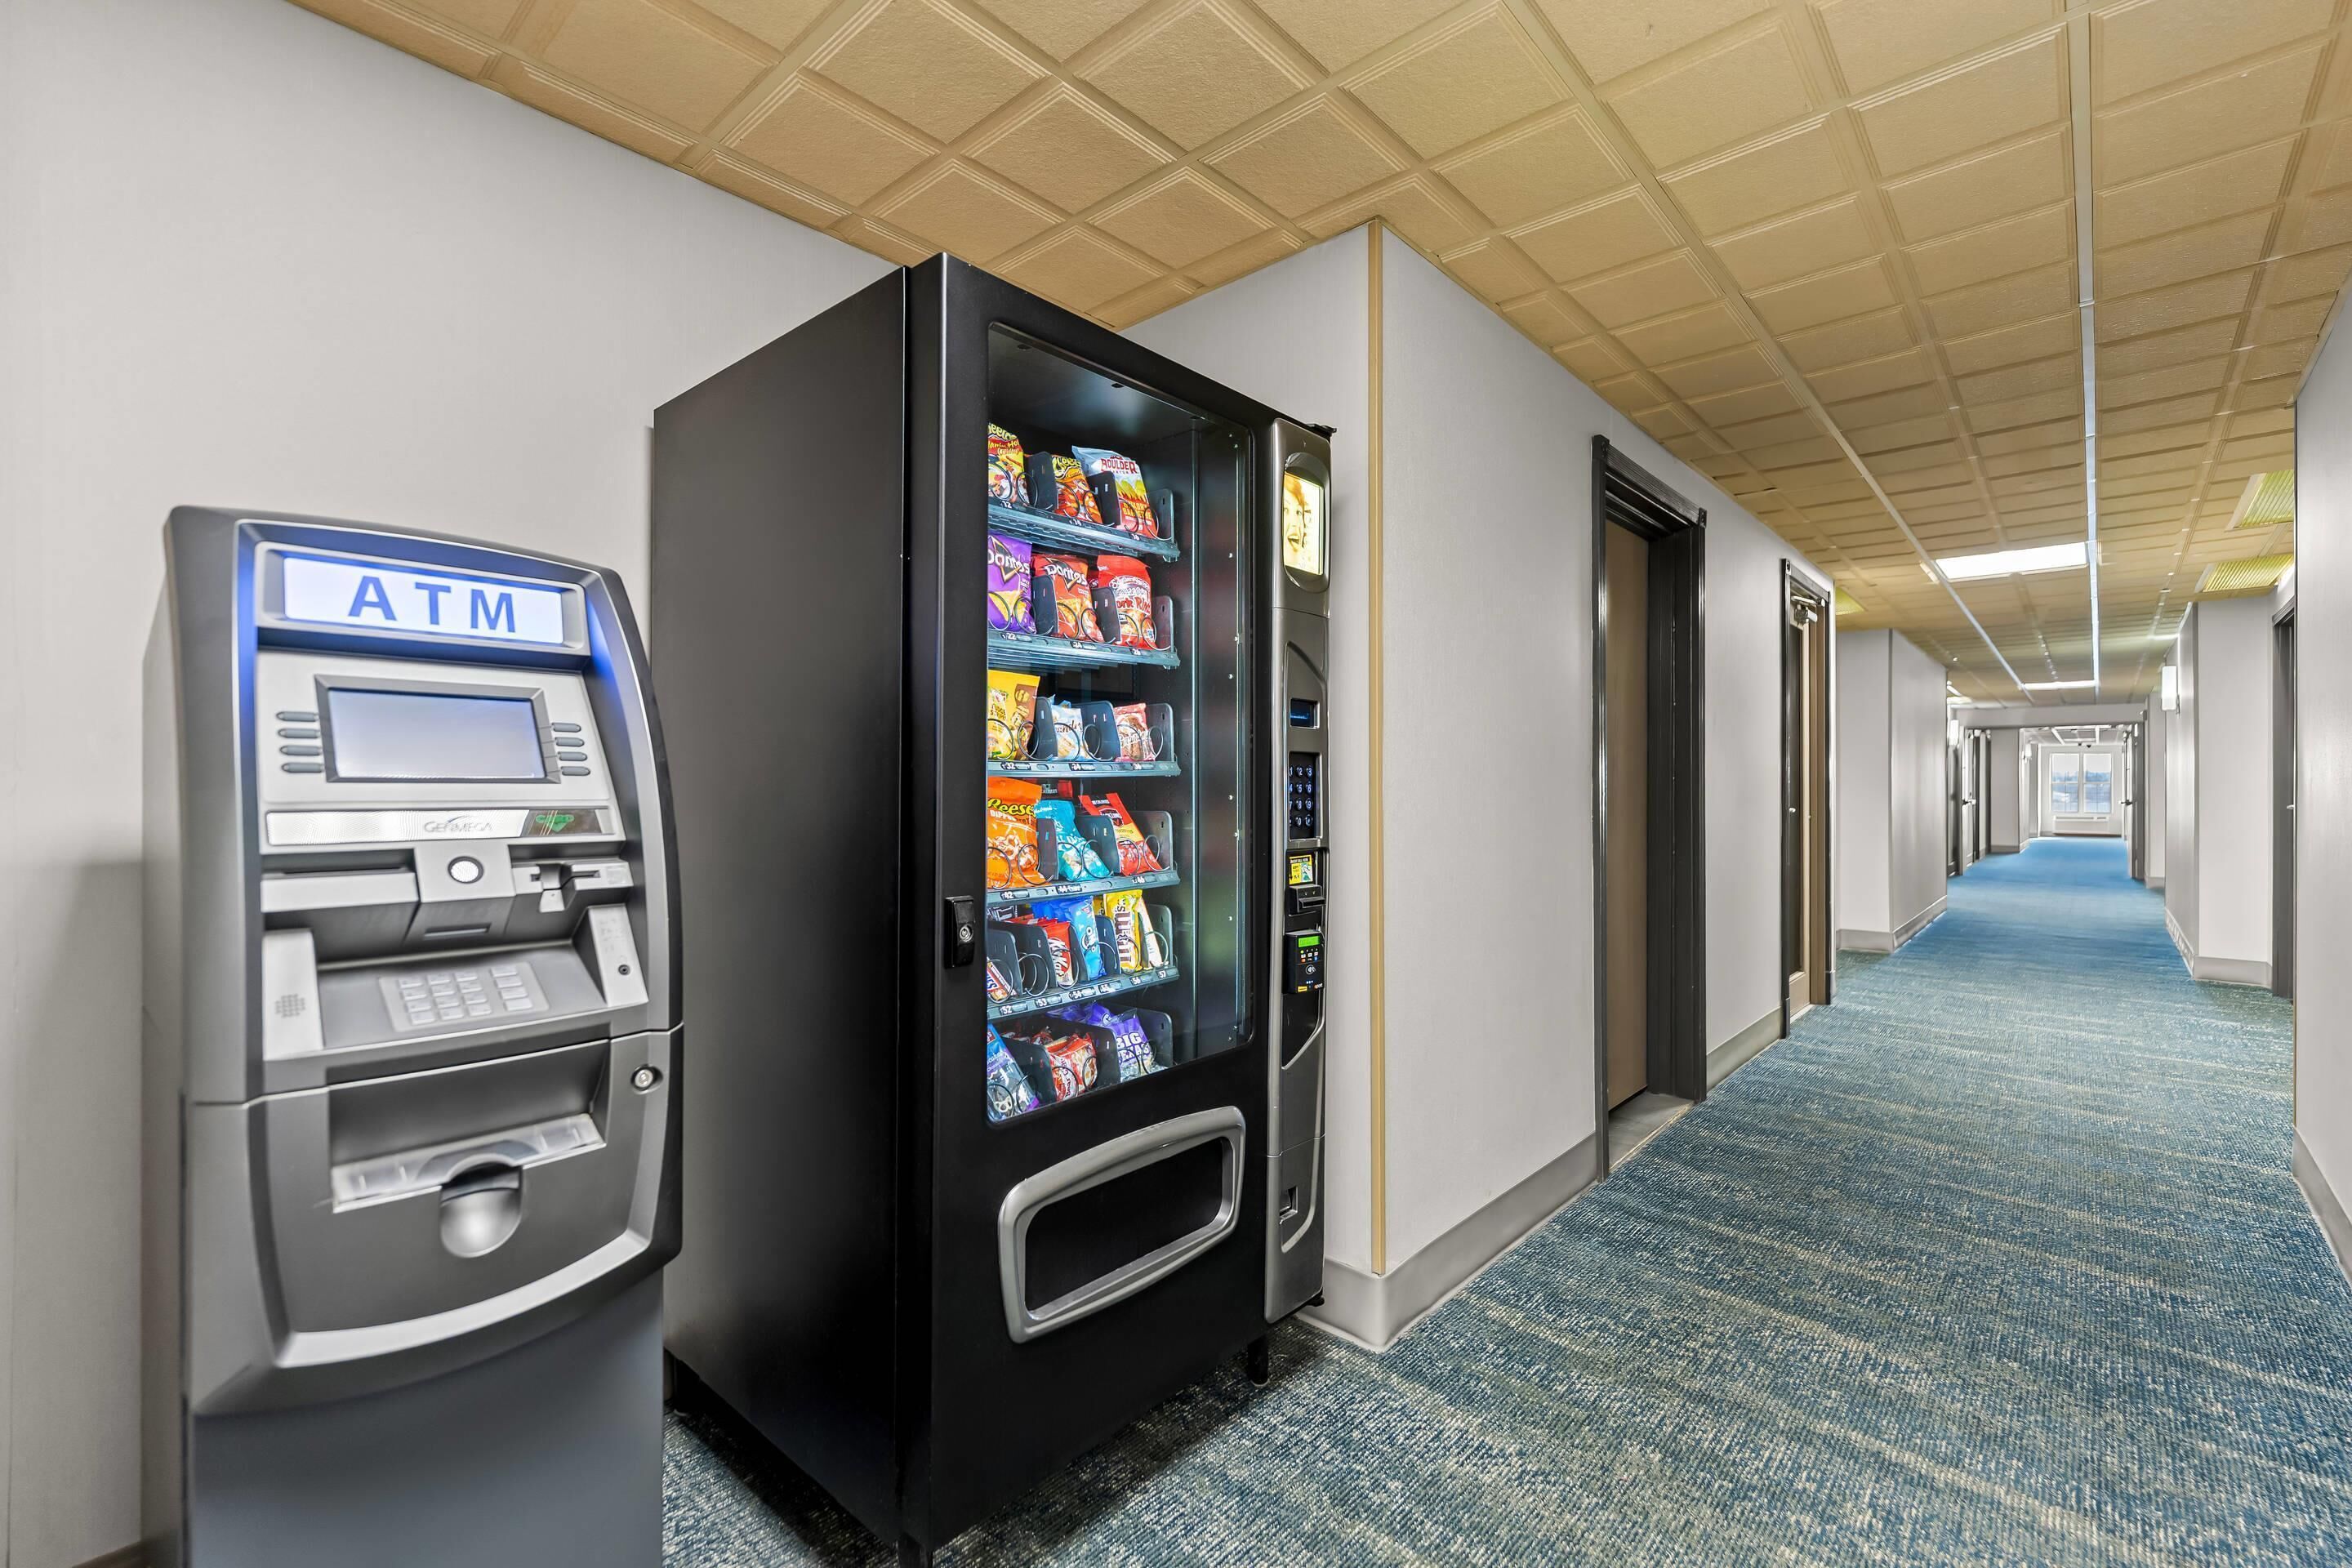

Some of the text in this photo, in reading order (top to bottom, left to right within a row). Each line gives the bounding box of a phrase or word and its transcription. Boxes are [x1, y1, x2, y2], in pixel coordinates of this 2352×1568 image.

[1044, 564, 1088, 586] Doritos
[348, 575, 516, 633] ATM
[1116, 1032, 1143, 1049] BIG
